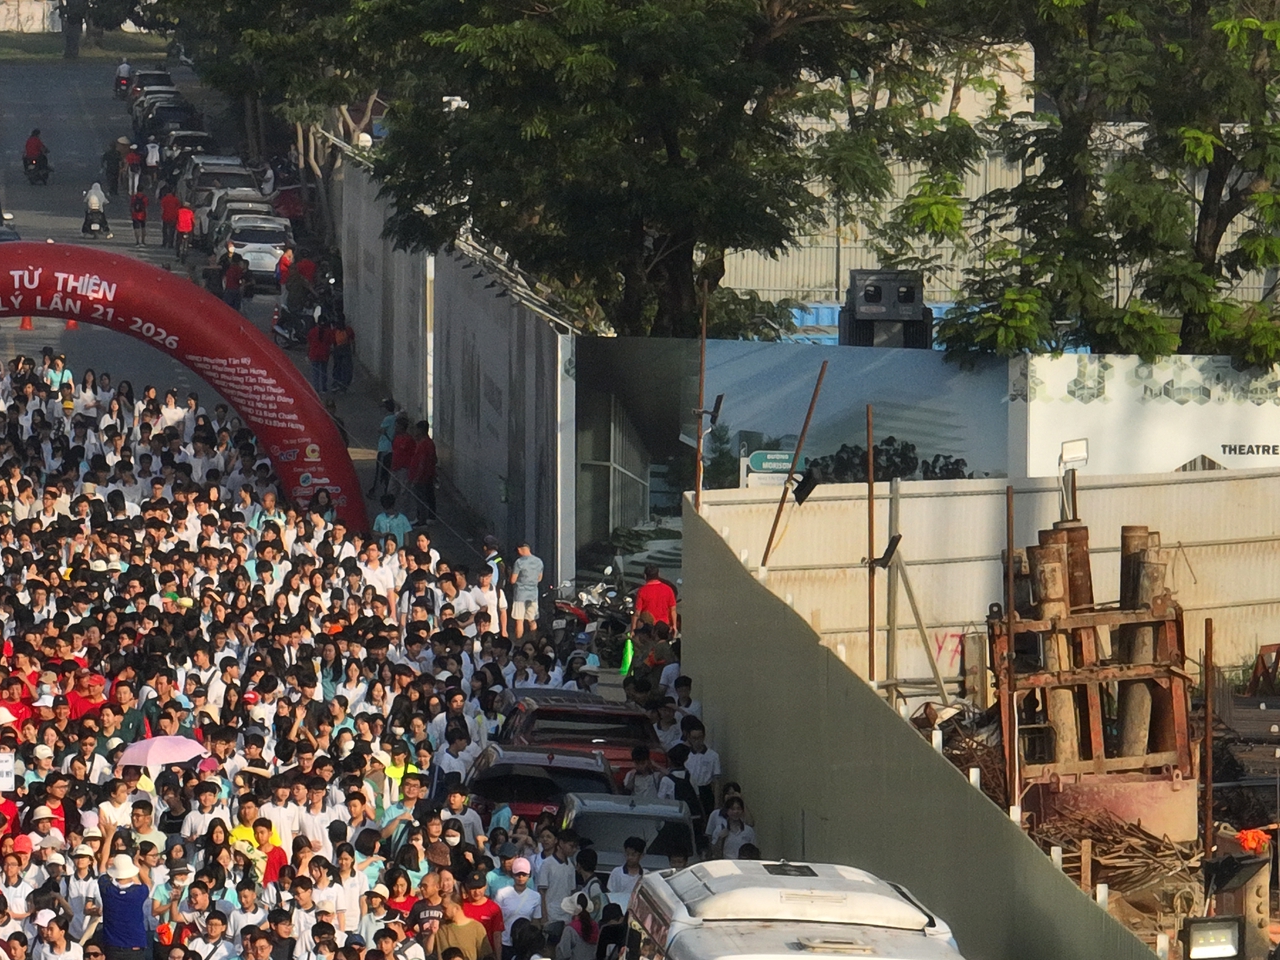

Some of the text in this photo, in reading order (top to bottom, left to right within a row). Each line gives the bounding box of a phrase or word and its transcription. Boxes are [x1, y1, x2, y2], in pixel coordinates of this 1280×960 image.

[9, 265, 43, 294] TỪ
[54, 270, 117, 302] THIỆN
[91, 303, 115, 322] 21
[128, 316, 180, 351] 2026
[1221, 445, 1280, 455] THEATRE
